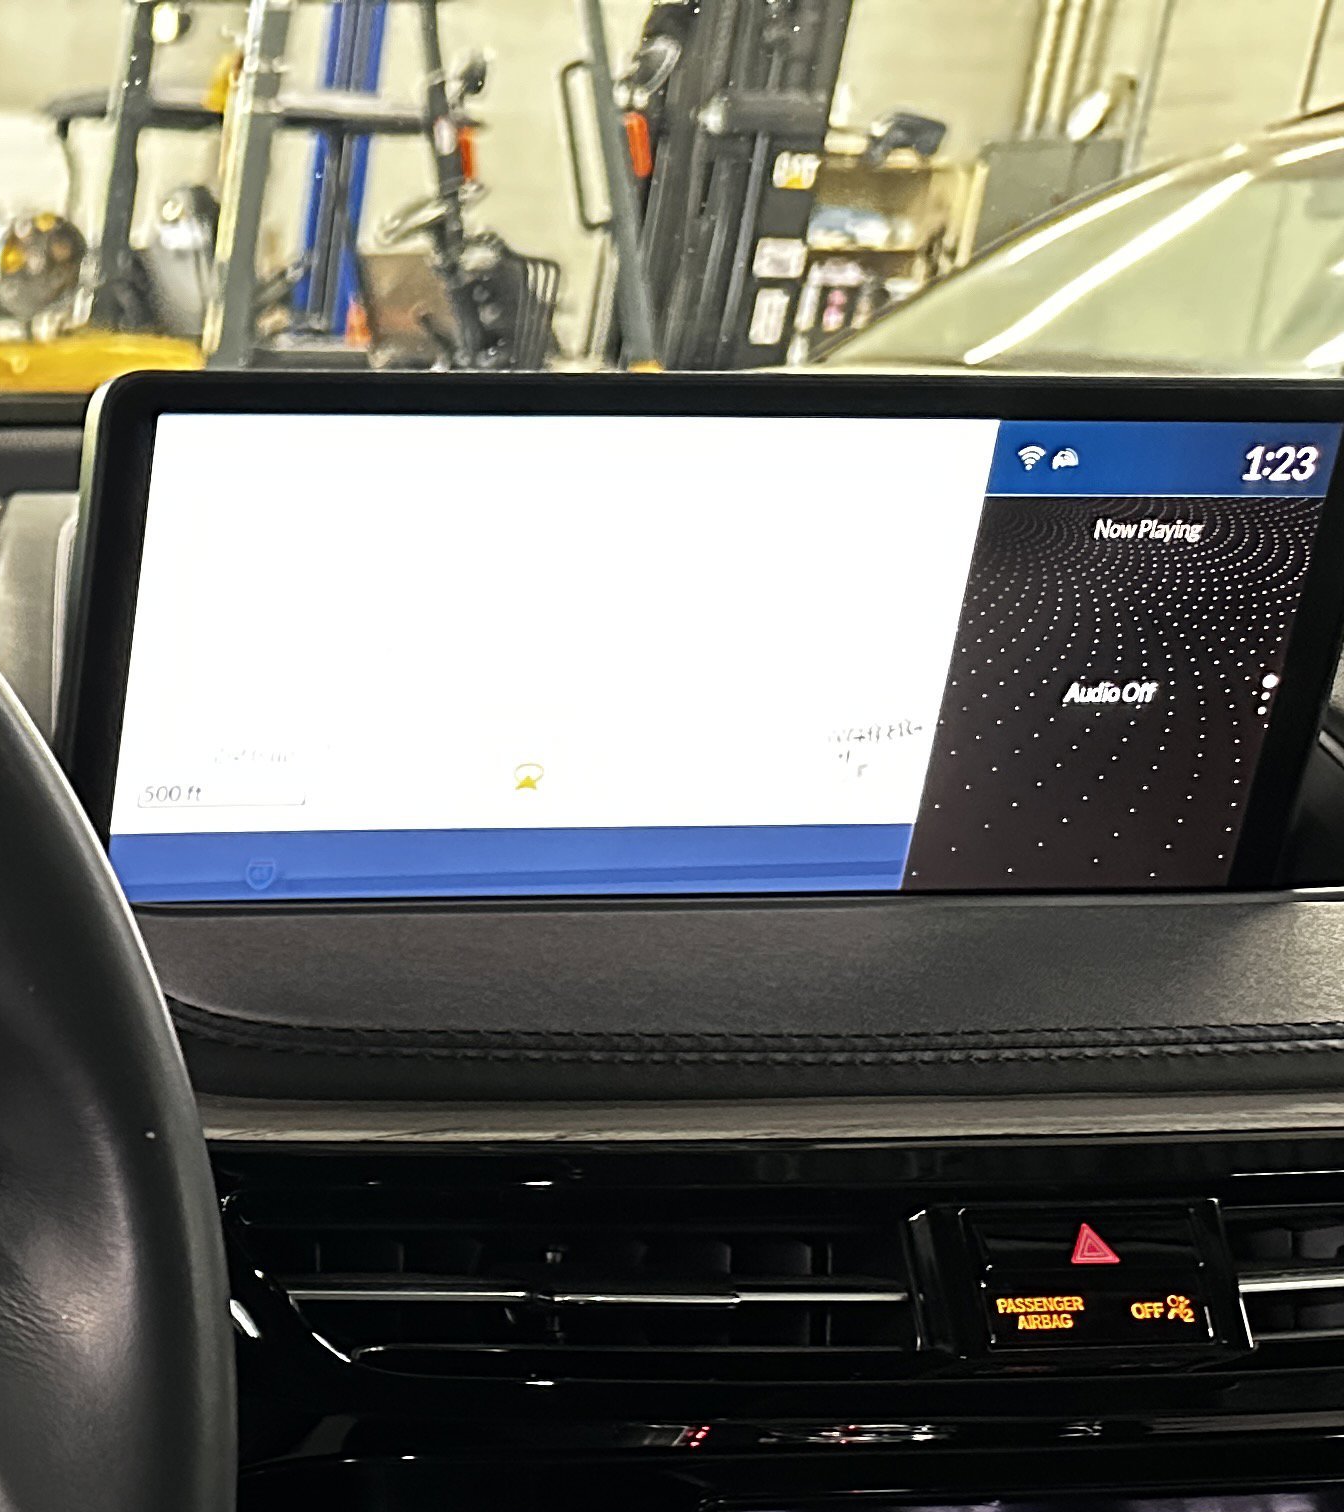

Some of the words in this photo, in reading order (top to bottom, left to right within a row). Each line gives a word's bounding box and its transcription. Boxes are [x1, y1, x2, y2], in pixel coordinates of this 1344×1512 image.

[1241, 445, 1319, 482] 1:23
[1093, 518, 1139, 541] Now
[1139, 518, 1204, 543] Playing
[1062, 681, 1120, 704] Audio
[1120, 681, 1159, 704] Off
[145, 785, 181, 802] 500
[996, 1296, 1084, 1315] PASSENGER
[1130, 1302, 1165, 1320] OFF
[1018, 1313, 1074, 1330] AIRBAG
